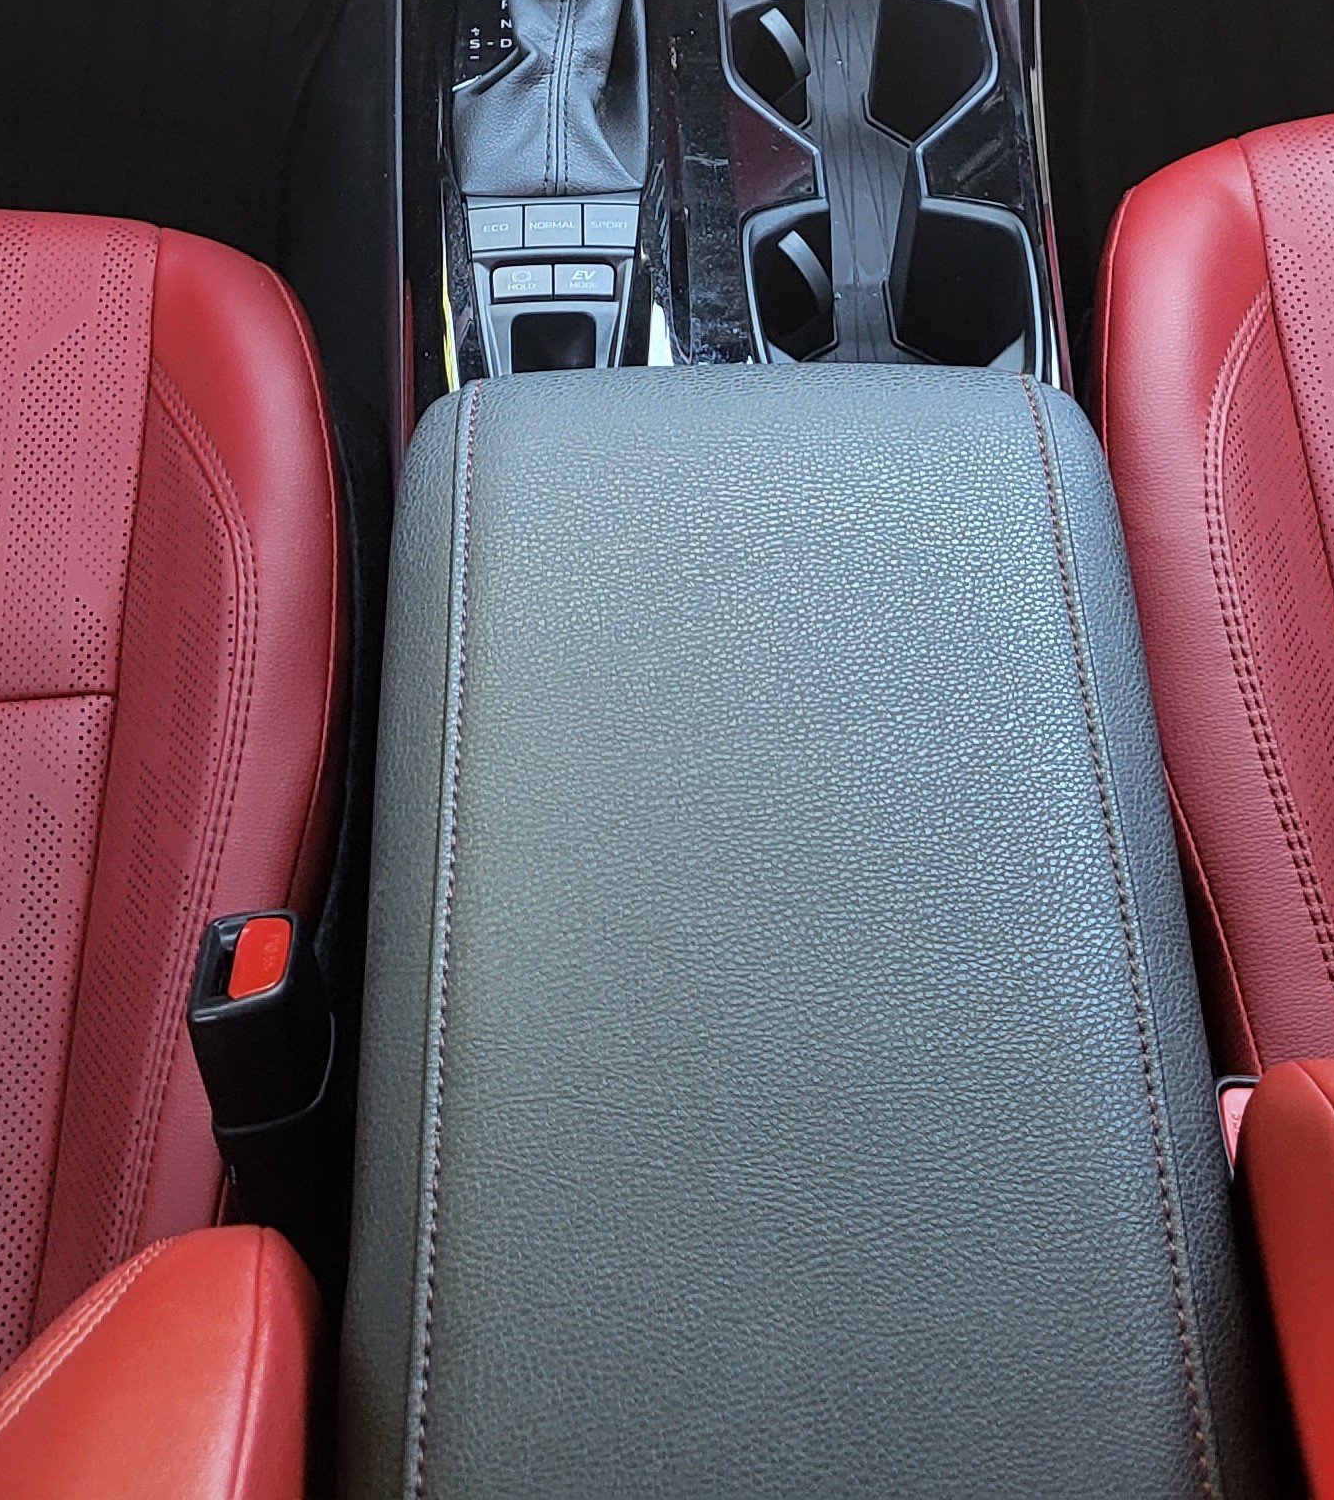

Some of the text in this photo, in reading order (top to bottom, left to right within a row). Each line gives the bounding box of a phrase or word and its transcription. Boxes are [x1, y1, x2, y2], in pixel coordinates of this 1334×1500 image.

[500, 18, 513, 29] N
[469, 38, 513, 49] S D
[482, 223, 509, 233] ECO
[529, 220, 576, 230] NORMAL
[590, 220, 629, 230] SPORT
[571, 269, 598, 281] EV
[507, 282, 536, 291] HOLD
[569, 281, 597, 290] MODE
